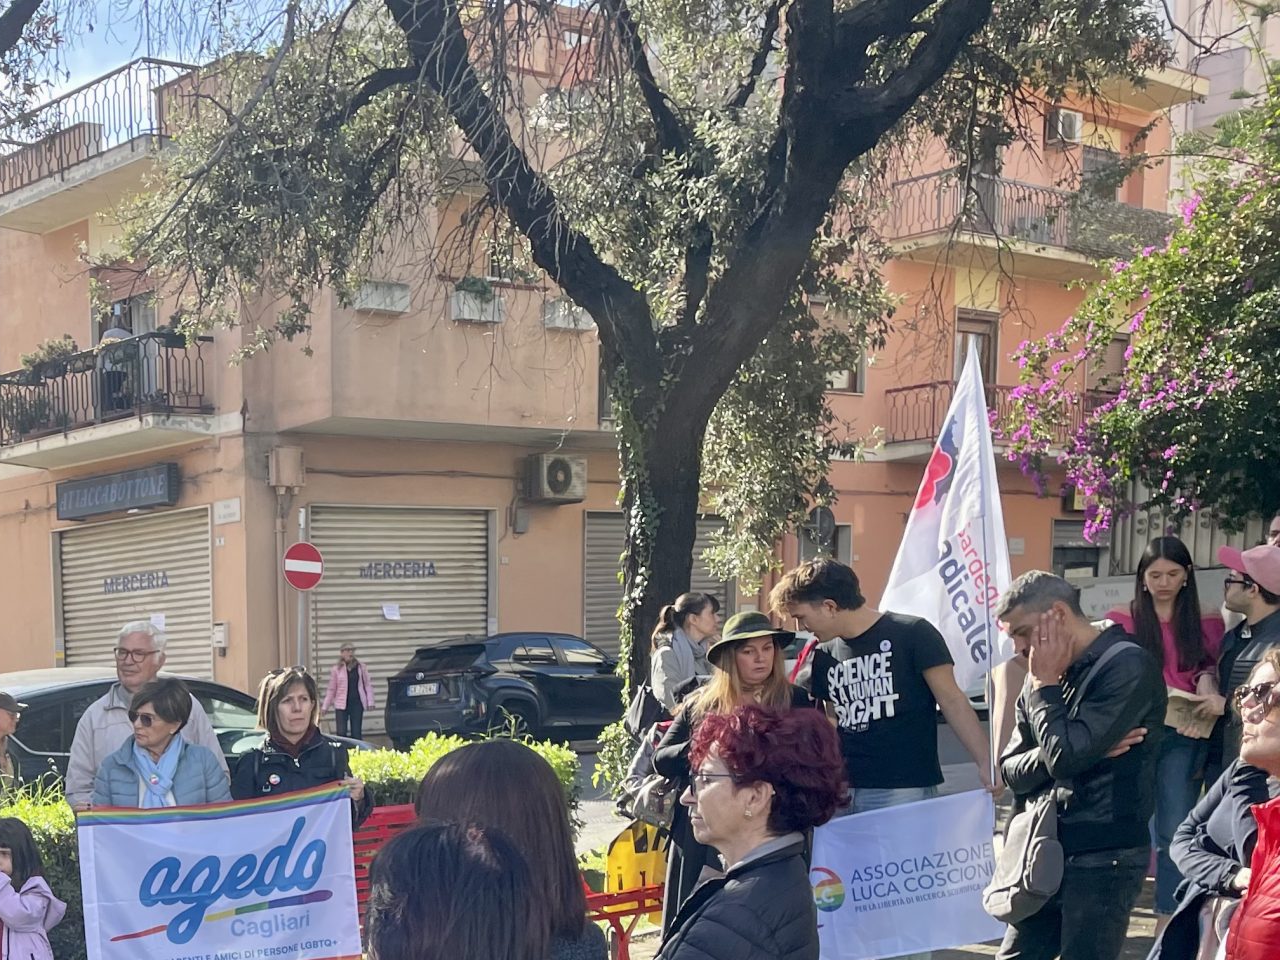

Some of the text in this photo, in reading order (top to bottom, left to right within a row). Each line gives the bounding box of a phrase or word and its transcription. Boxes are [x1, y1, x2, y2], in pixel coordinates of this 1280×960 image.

[59, 473, 166, 511] ATTACCABOTTONE
[104, 569, 169, 594] MERCERIA
[359, 561, 437, 579] MERCERIA
[827, 652, 893, 692] SCIENCE
[839, 686, 848, 704] A
[848, 677, 893, 701] HUMAN
[834, 694, 899, 727] RIGHT
[851, 842, 991, 884] ASSOCIAZIONE
[139, 816, 327, 945] agedo
[851, 861, 993, 902] LUCA COSCIONI
[855, 904, 868, 913] PER
[869, 903, 877, 911] LA
[878, 897, 906, 910] LIBERTÀ
[906, 897, 914, 905] DI
[915, 891, 946, 903] RICERCA
[231, 910, 311, 938] Cagliari
[245, 949, 255, 958] DI
[257, 944, 299, 957] PERSONE
[301, 939, 338, 950] LGBTQ+
